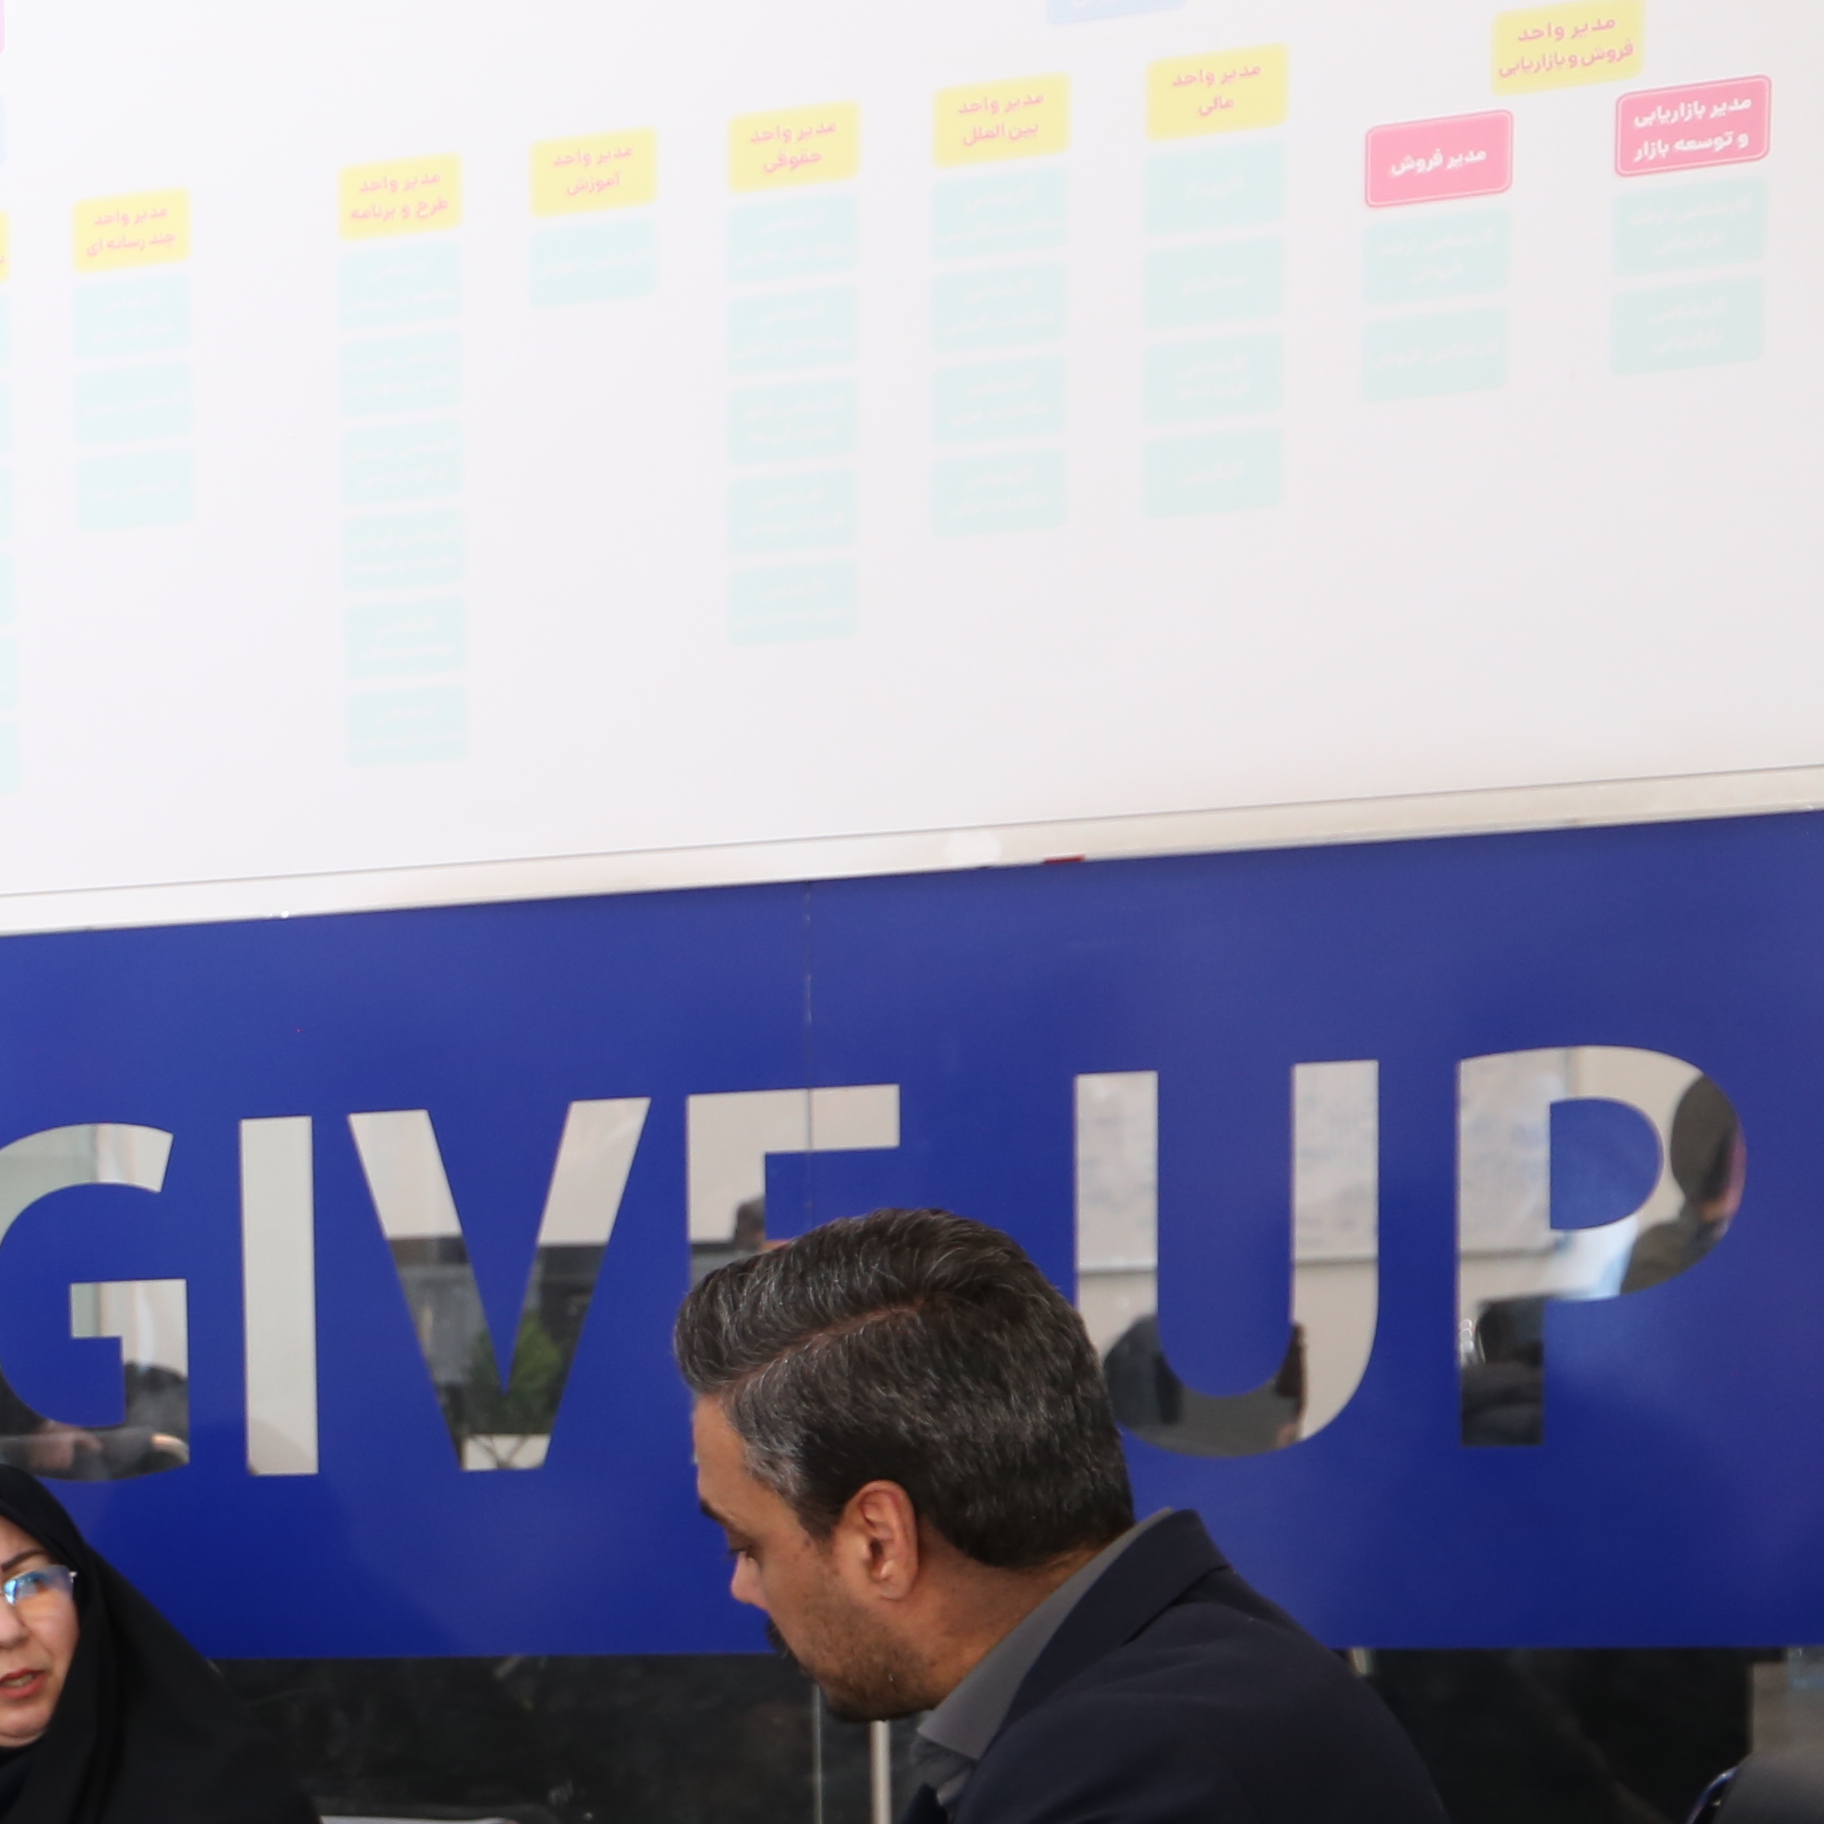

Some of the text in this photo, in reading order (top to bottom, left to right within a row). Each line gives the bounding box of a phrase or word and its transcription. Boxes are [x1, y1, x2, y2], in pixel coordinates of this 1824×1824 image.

[1518, 18, 1616, 42] مدیر واحد
[1172, 66, 1262, 88] مدیر واحد
[957, 95, 1046, 116] مدیر واحد
[1198, 95, 1234, 118] مالی
[1634, 98, 1753, 128] مدیر بازاریابی
[750, 122, 838, 144] مدیر واحد
[553, 147, 633, 168] مدیر واحد
[1634, 131, 1751, 163] و توسعه بازار
[1391, 149, 1488, 178] مدیر فروش
[359, 173, 441, 193] مدیر واحد
[1075, 1044, 1747, 1458] UP
